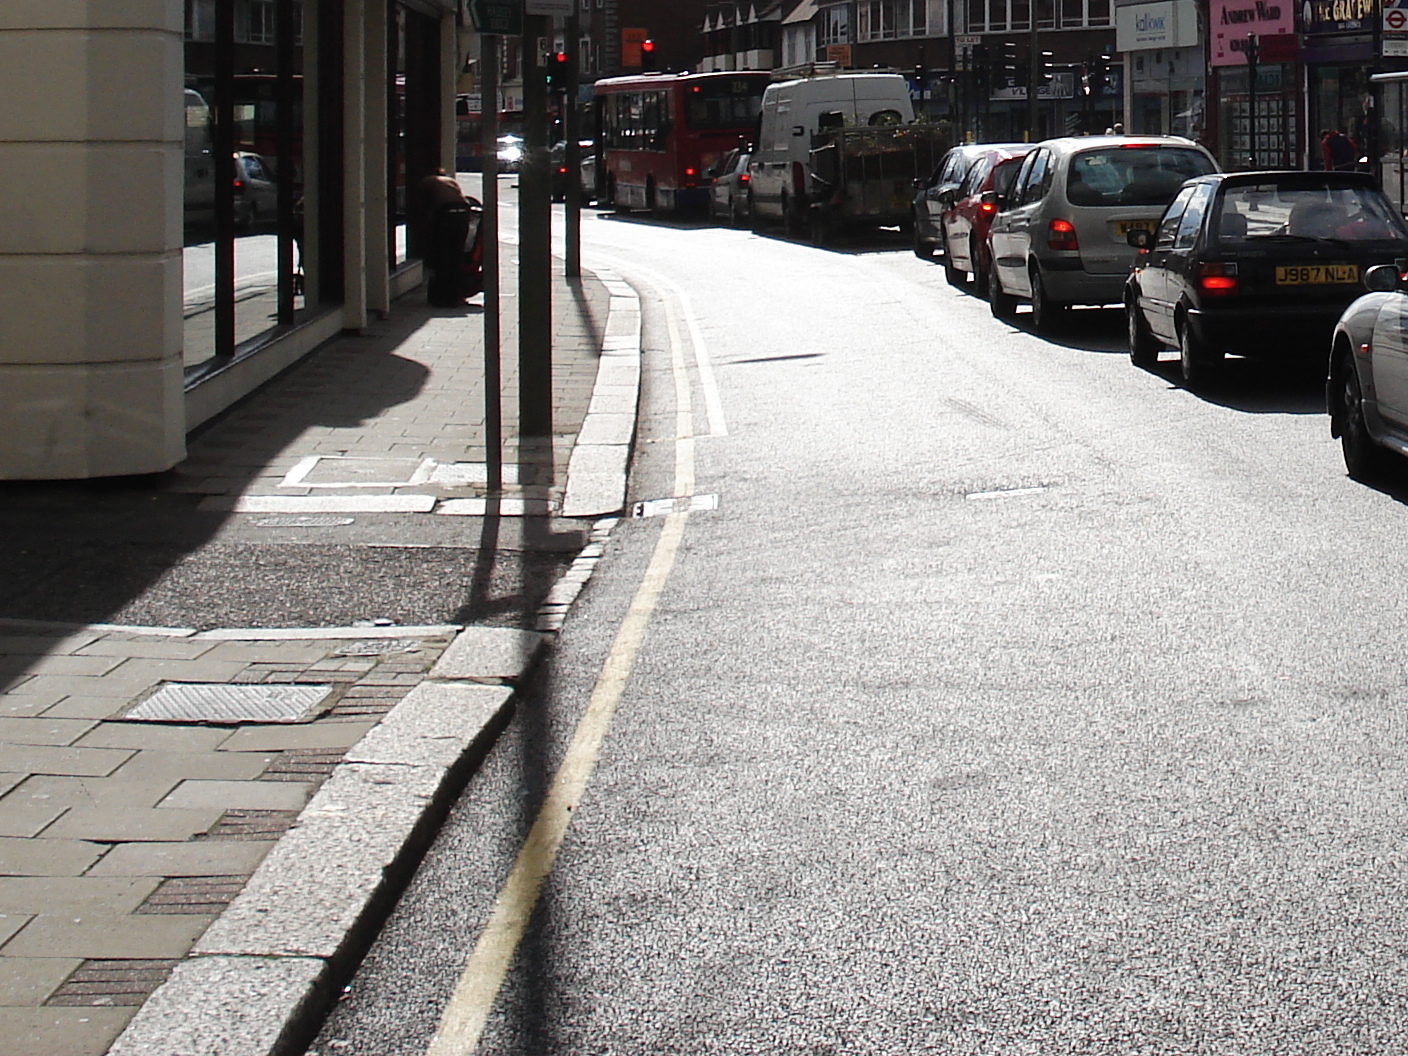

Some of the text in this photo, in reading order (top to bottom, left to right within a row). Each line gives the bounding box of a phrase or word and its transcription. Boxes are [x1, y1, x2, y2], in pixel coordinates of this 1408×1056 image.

[1220, 1, 1281, 25] ANDREW WARD
[1278, 267, 1321, 282] J987
